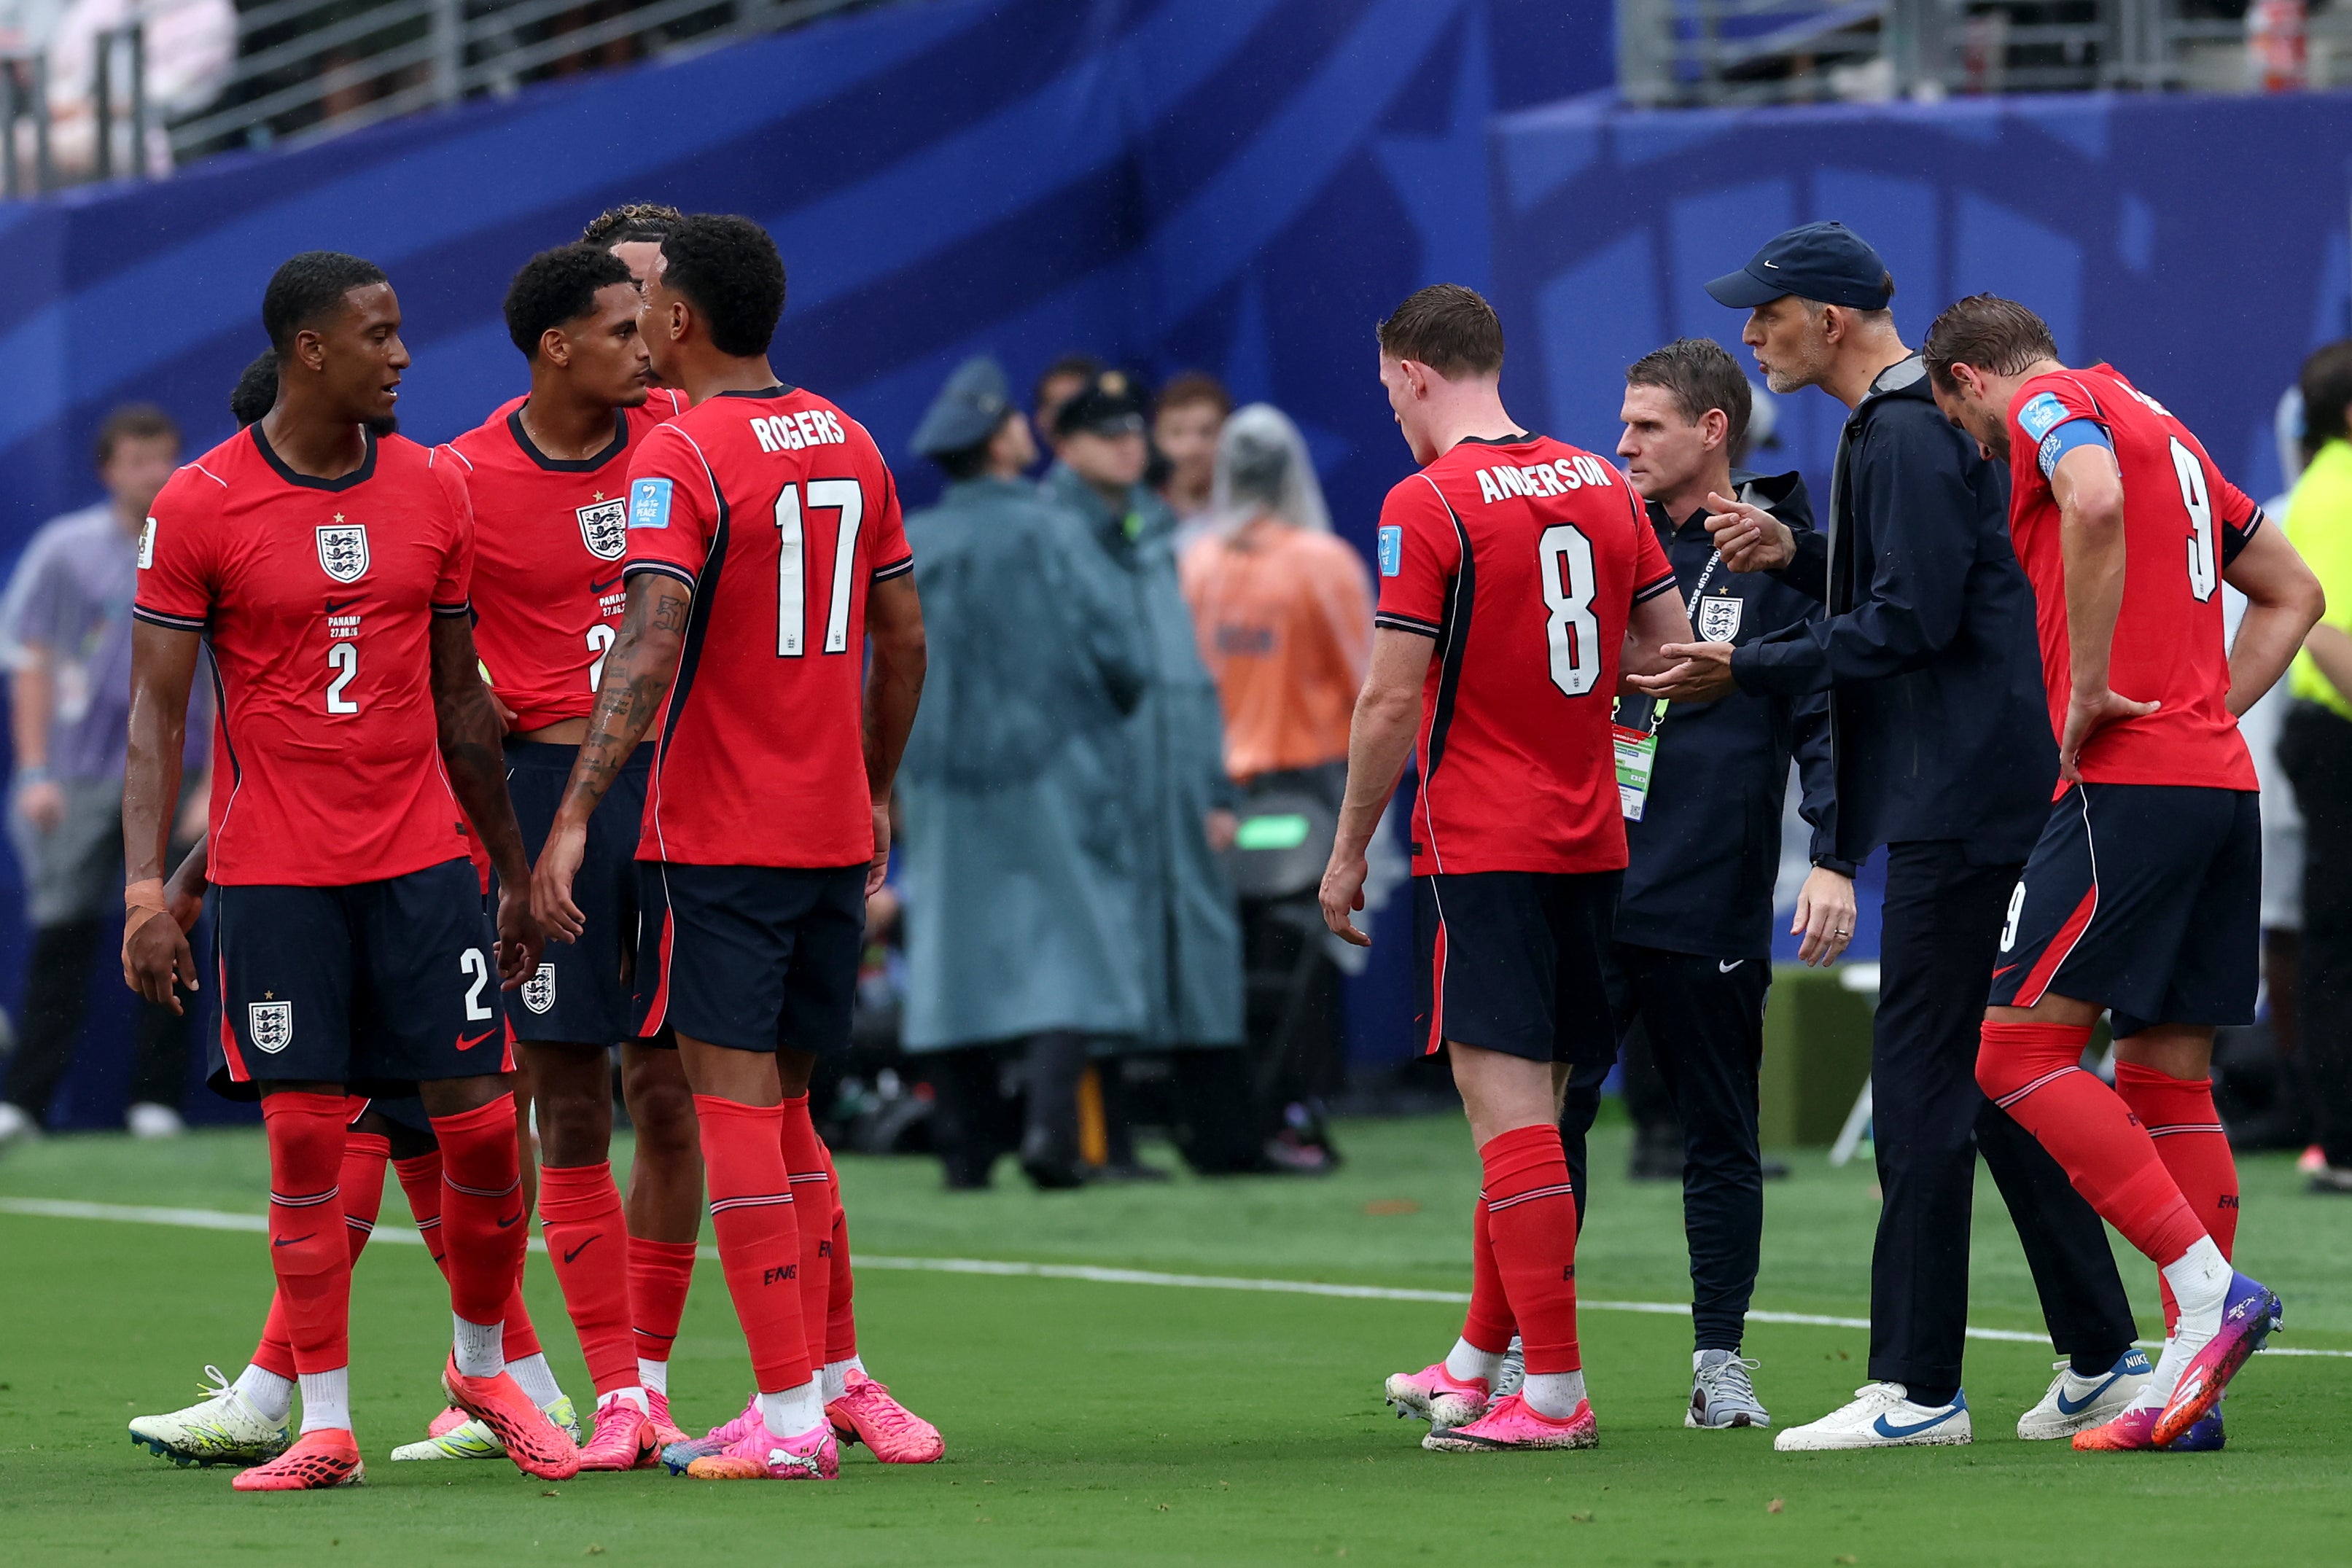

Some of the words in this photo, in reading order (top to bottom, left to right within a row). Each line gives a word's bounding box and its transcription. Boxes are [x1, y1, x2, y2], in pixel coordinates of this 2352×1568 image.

[749, 410, 846, 453] ROGERS
[1475, 456, 1613, 504] ANDERSON
[636, 508, 658, 518] PEACE
[2170, 435, 2217, 604] 9
[775, 478, 862, 658] 17
[1705, 548, 1721, 573] ORLD
[1697, 572, 1710, 590] CUP
[599, 593, 627, 607] PANAM
[602, 604, 626, 617] 27.06.2
[1538, 523, 1603, 698] 8
[1686, 588, 1702, 620] 2026
[328, 615, 362, 627] PANAMA
[330, 627, 359, 638] 27.06.26
[327, 641, 358, 714] 2
[2000, 881, 2026, 953] 9
[459, 948, 492, 1021] 2
[818, 1240, 833, 1259] EN
[764, 1264, 797, 1286] ENG
[2125, 1353, 2149, 1369] NIKE
